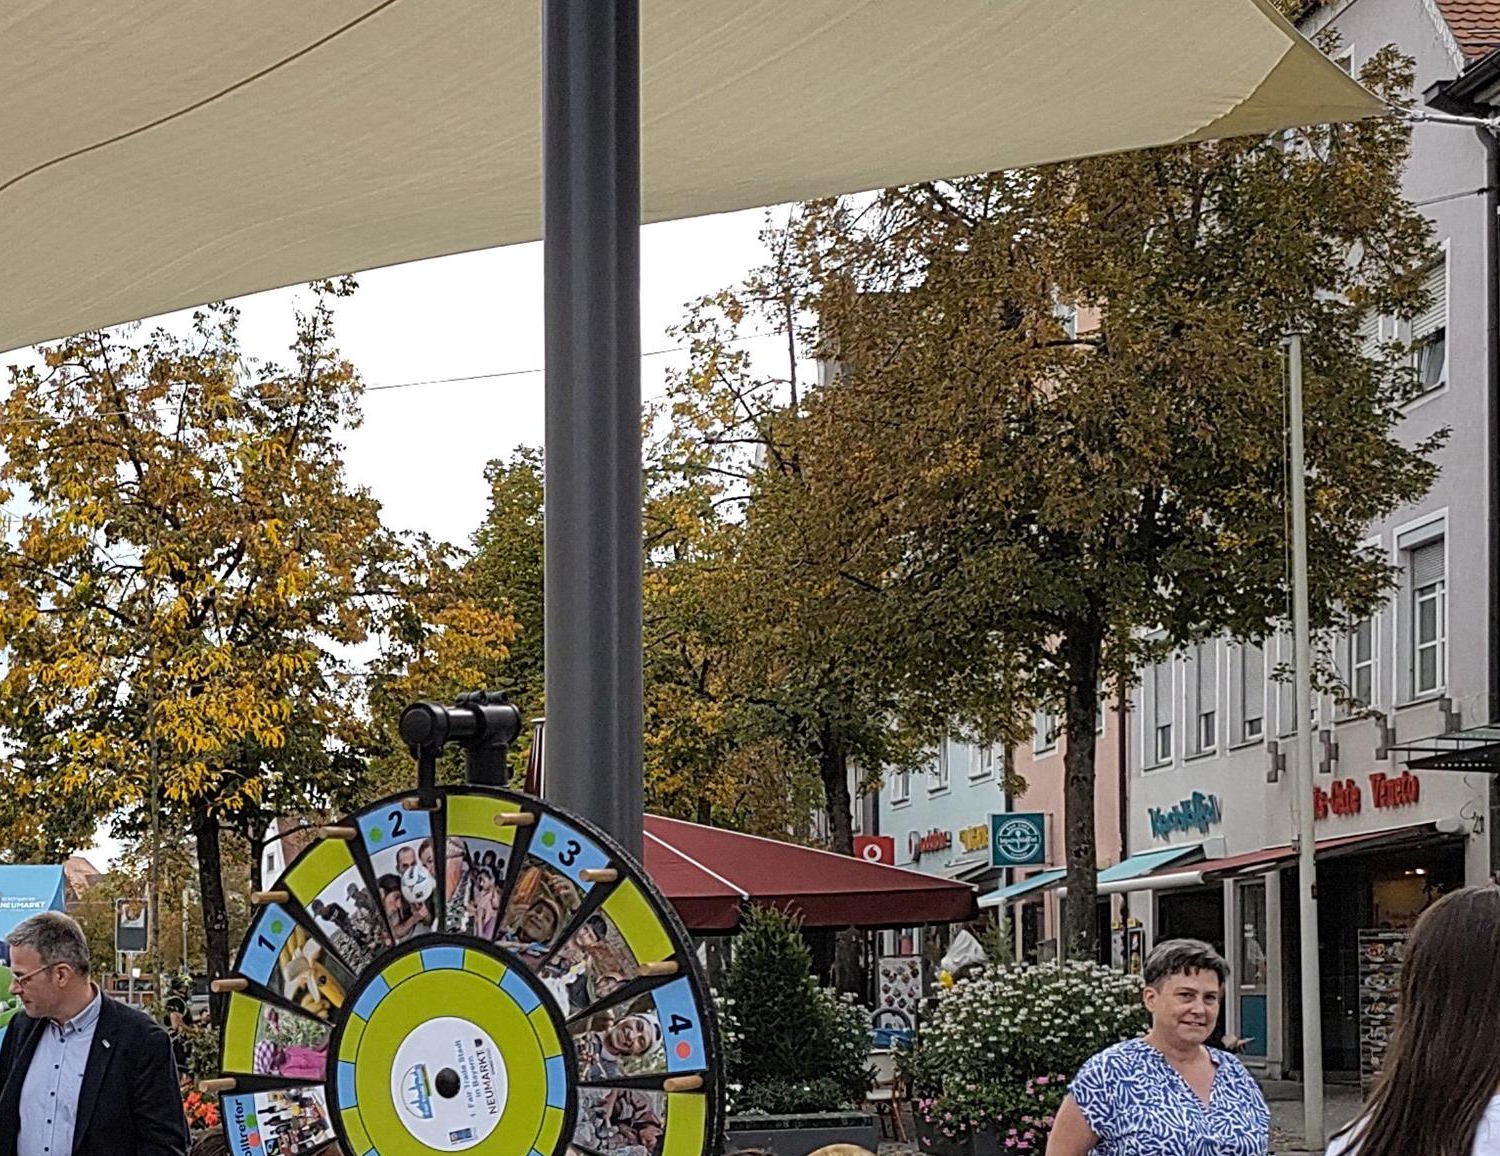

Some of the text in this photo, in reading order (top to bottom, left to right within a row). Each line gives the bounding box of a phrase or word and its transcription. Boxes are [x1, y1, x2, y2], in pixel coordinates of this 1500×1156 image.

[388, 810, 407, 838] 2
[558, 839, 582, 868] 3
[0, 901, 46, 909] NEUMARKT
[257, 934, 276, 953] 1
[668, 1014, 693, 1036] 4
[468, 1056, 479, 1087] Bayern
[476, 1050, 497, 1115] NEUMARKT
